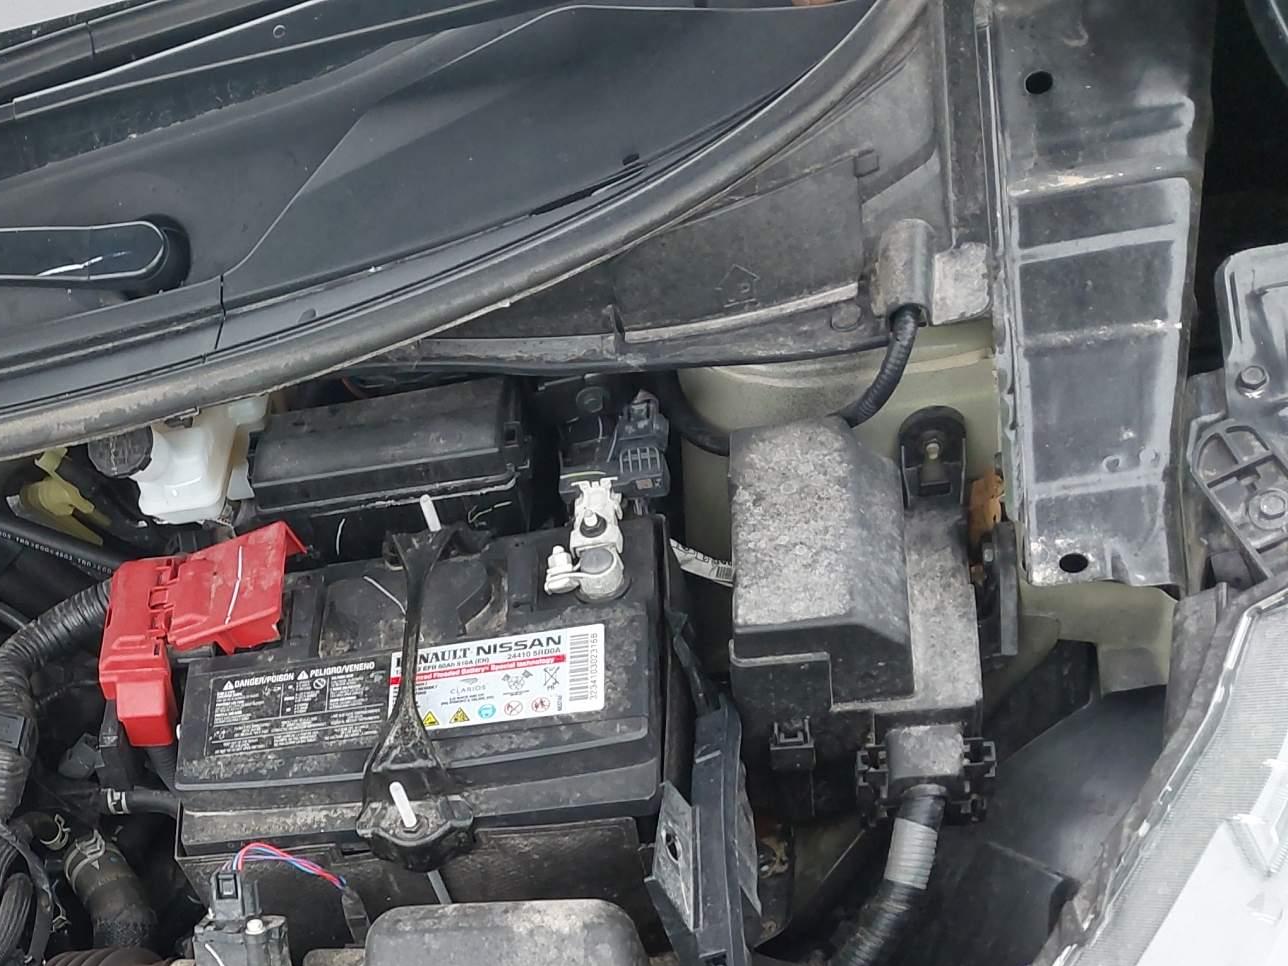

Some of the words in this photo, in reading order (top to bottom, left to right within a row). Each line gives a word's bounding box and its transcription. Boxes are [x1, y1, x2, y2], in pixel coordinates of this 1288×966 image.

[476, 635, 561, 656] NISSAN
[309, 661, 375, 678] PELIGRO/VENENO
[234, 672, 295, 688] DANGER/POISON
[450, 684, 487, 695] CLARIOS
